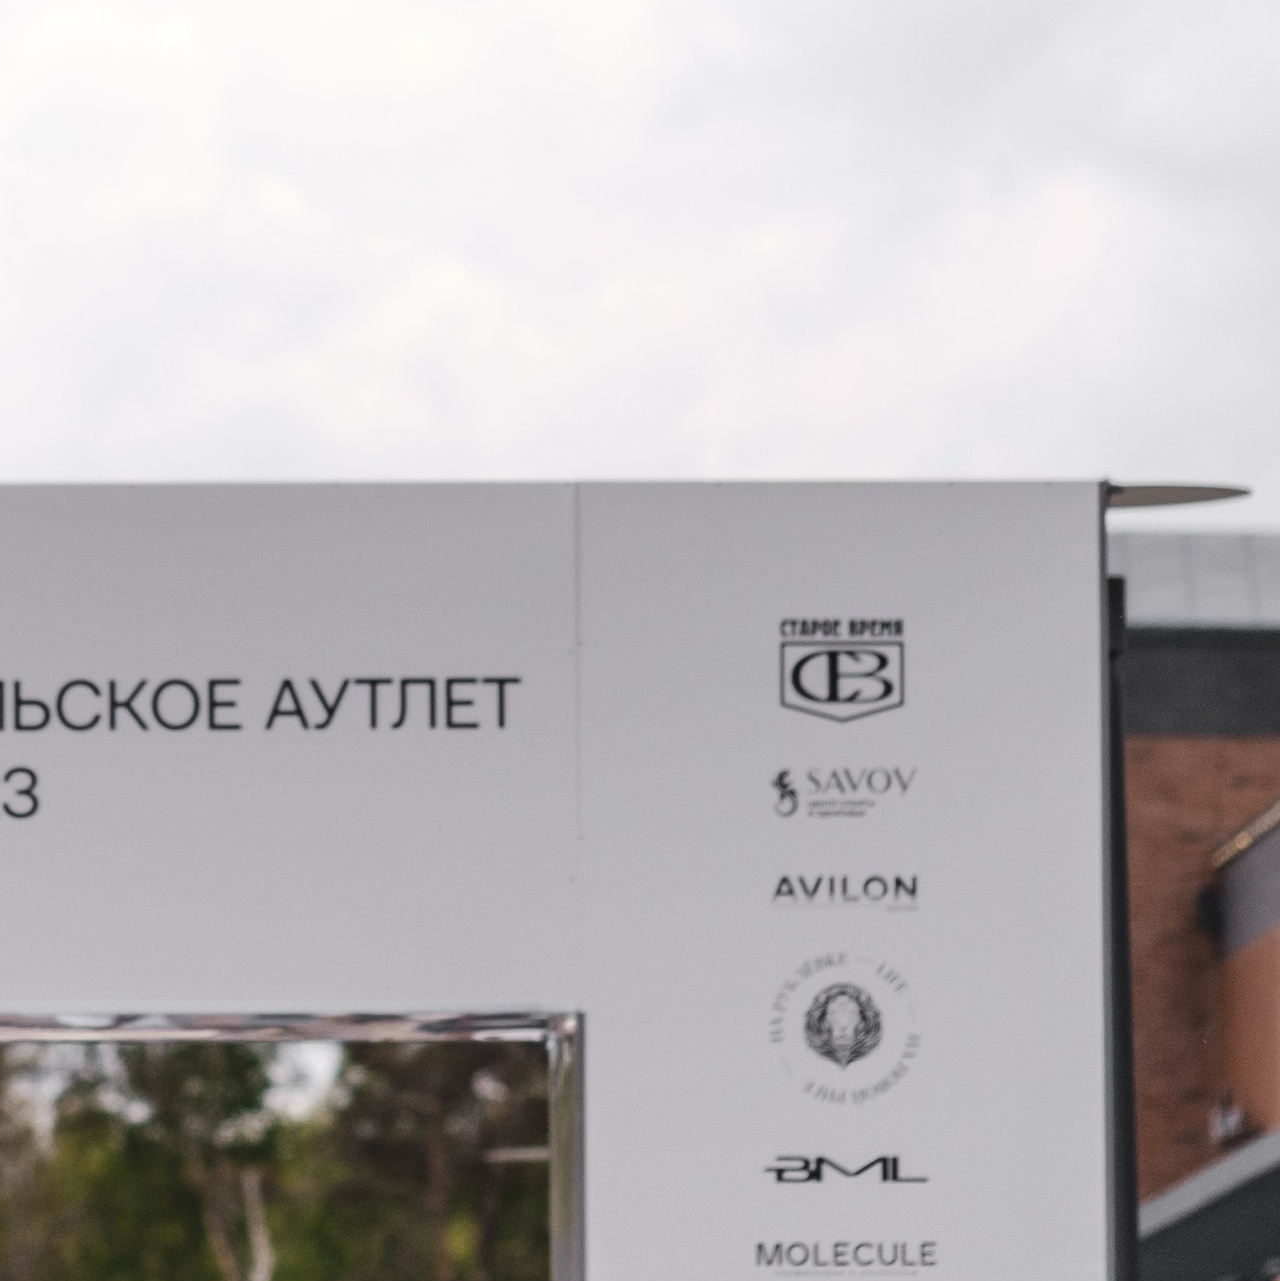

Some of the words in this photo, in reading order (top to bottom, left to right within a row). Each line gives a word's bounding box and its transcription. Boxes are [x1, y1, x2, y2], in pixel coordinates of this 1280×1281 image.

[265, 677, 521, 730] АУТЛЕТ
[806, 767, 917, 795] SAVOY
[773, 876, 918, 901] AVILON
[766, 1156, 927, 1183] BML
[756, 1241, 937, 1267] MOLECULE
